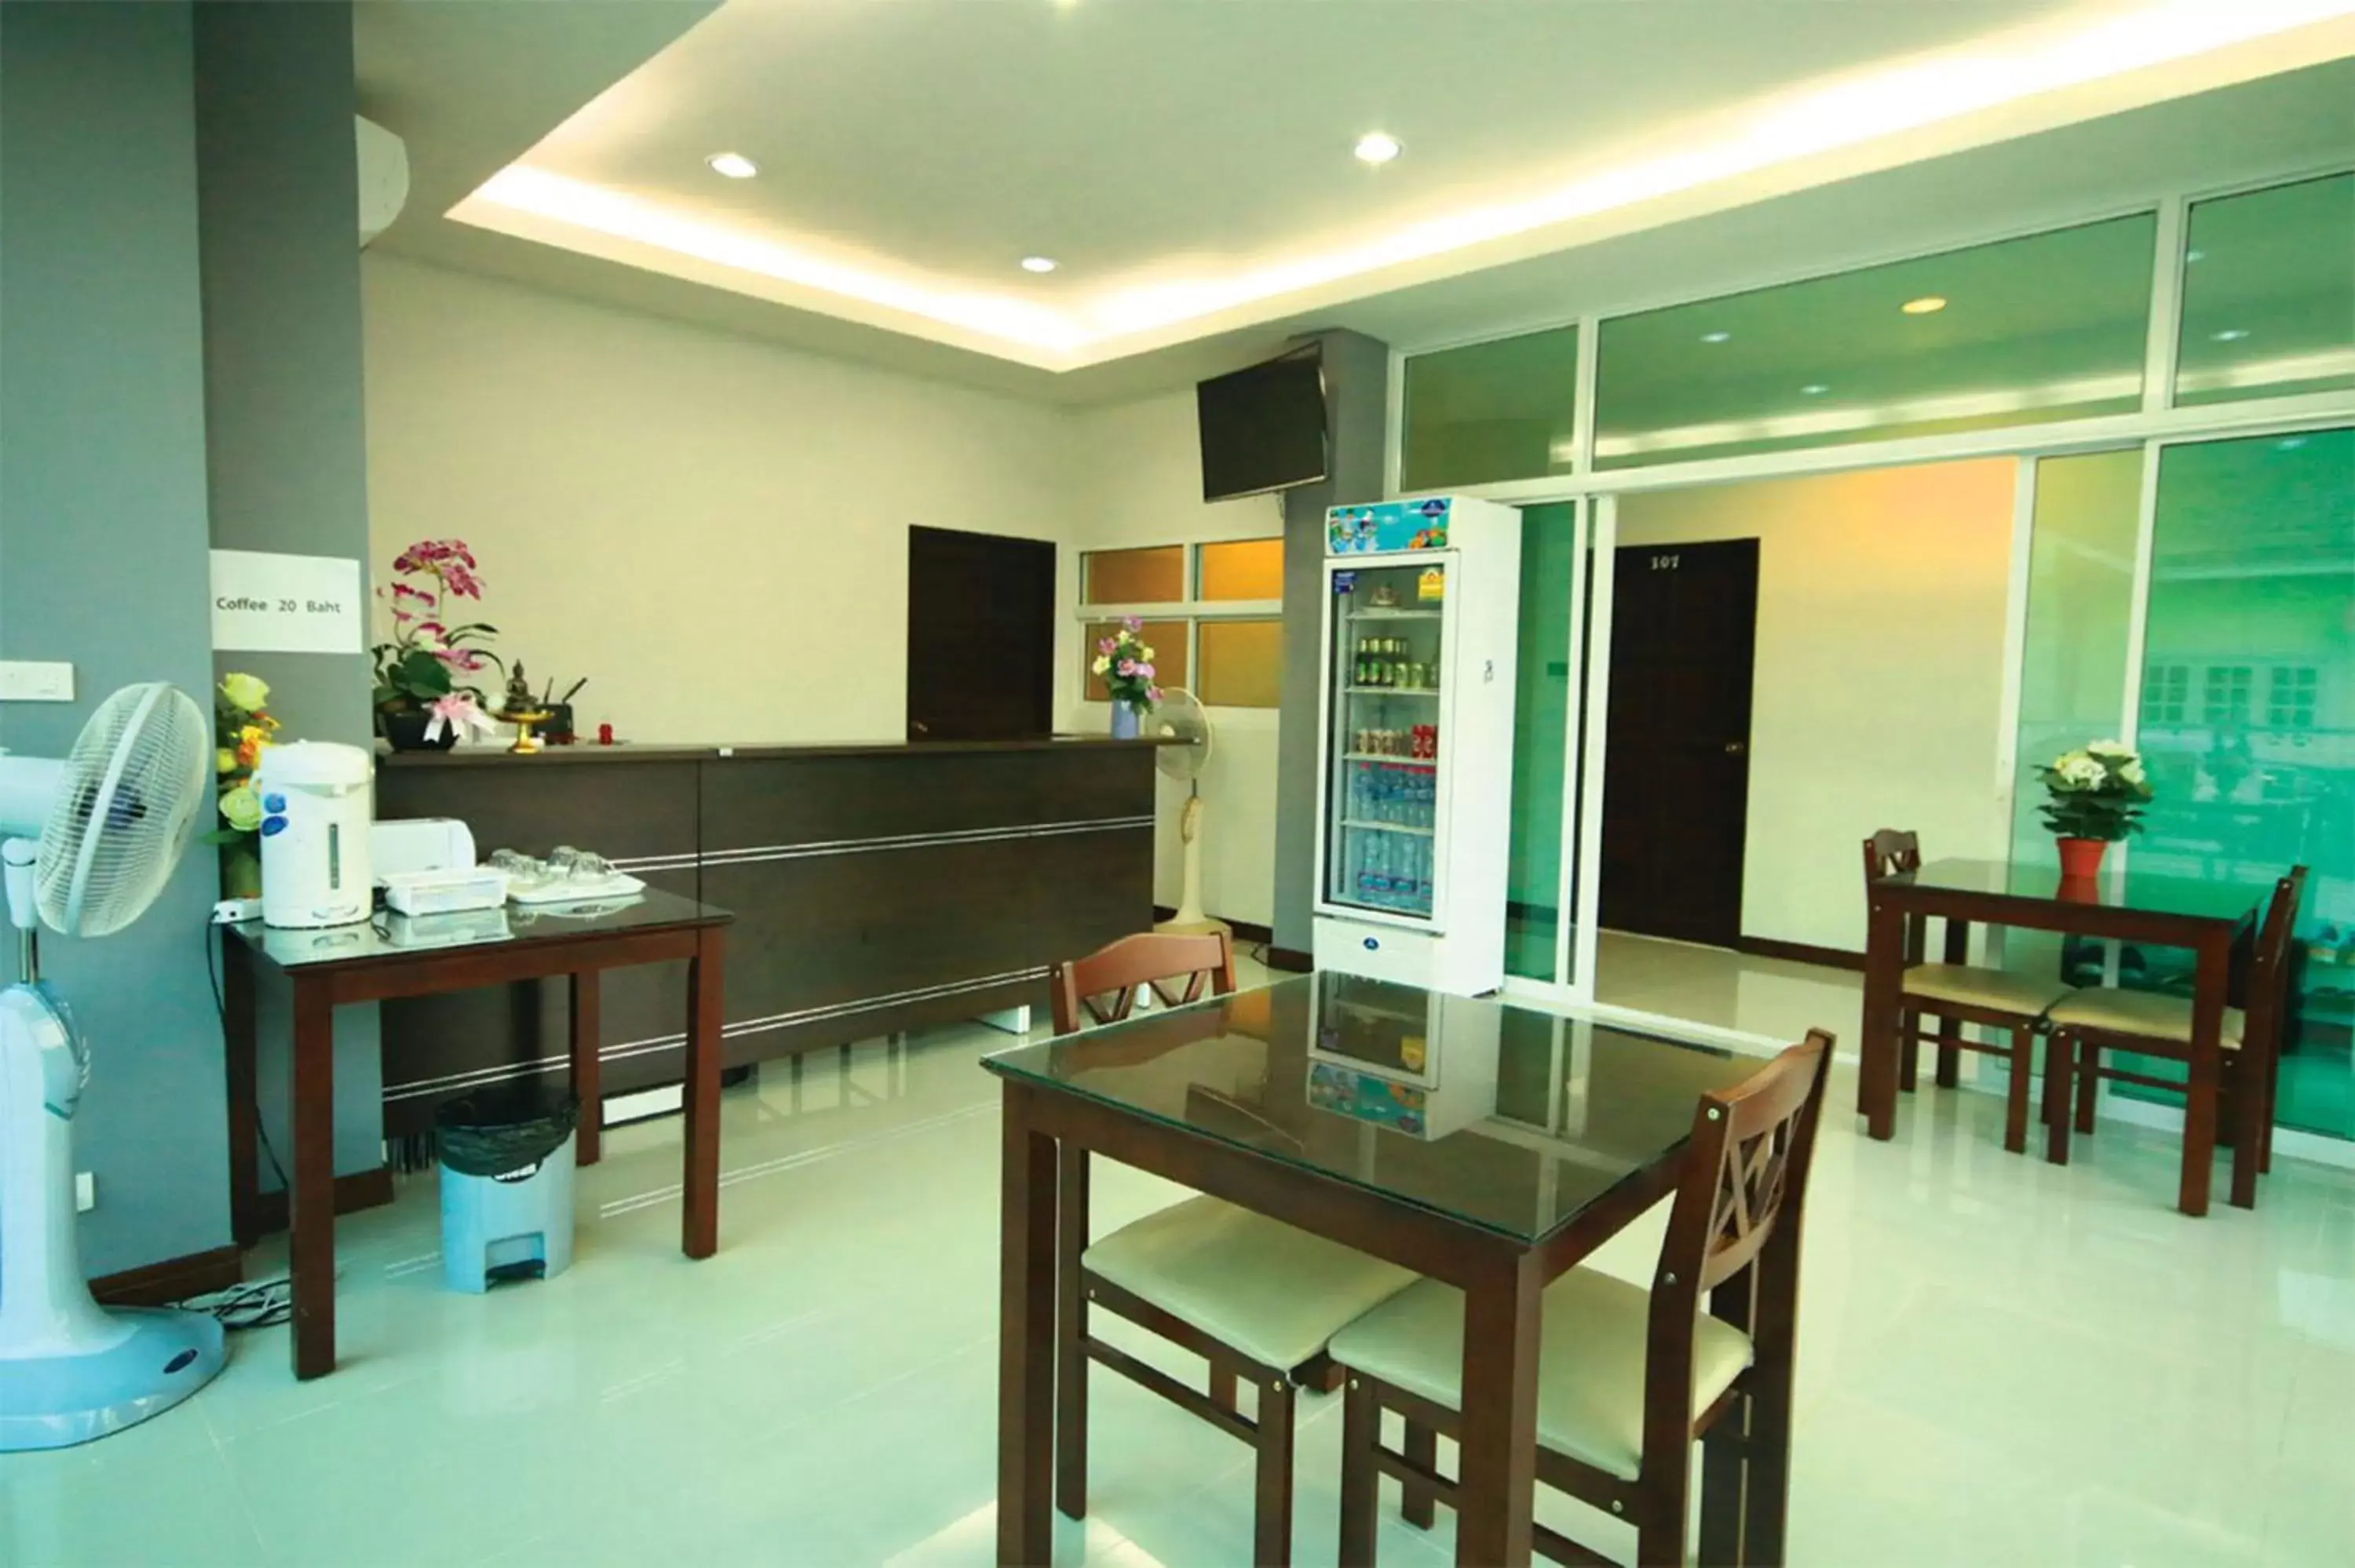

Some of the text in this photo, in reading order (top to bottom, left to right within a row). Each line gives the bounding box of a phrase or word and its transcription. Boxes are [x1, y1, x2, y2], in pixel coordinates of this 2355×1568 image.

[1651, 555, 1680, 570] 107
[216, 596, 341, 613] Coffee 20 Baht
